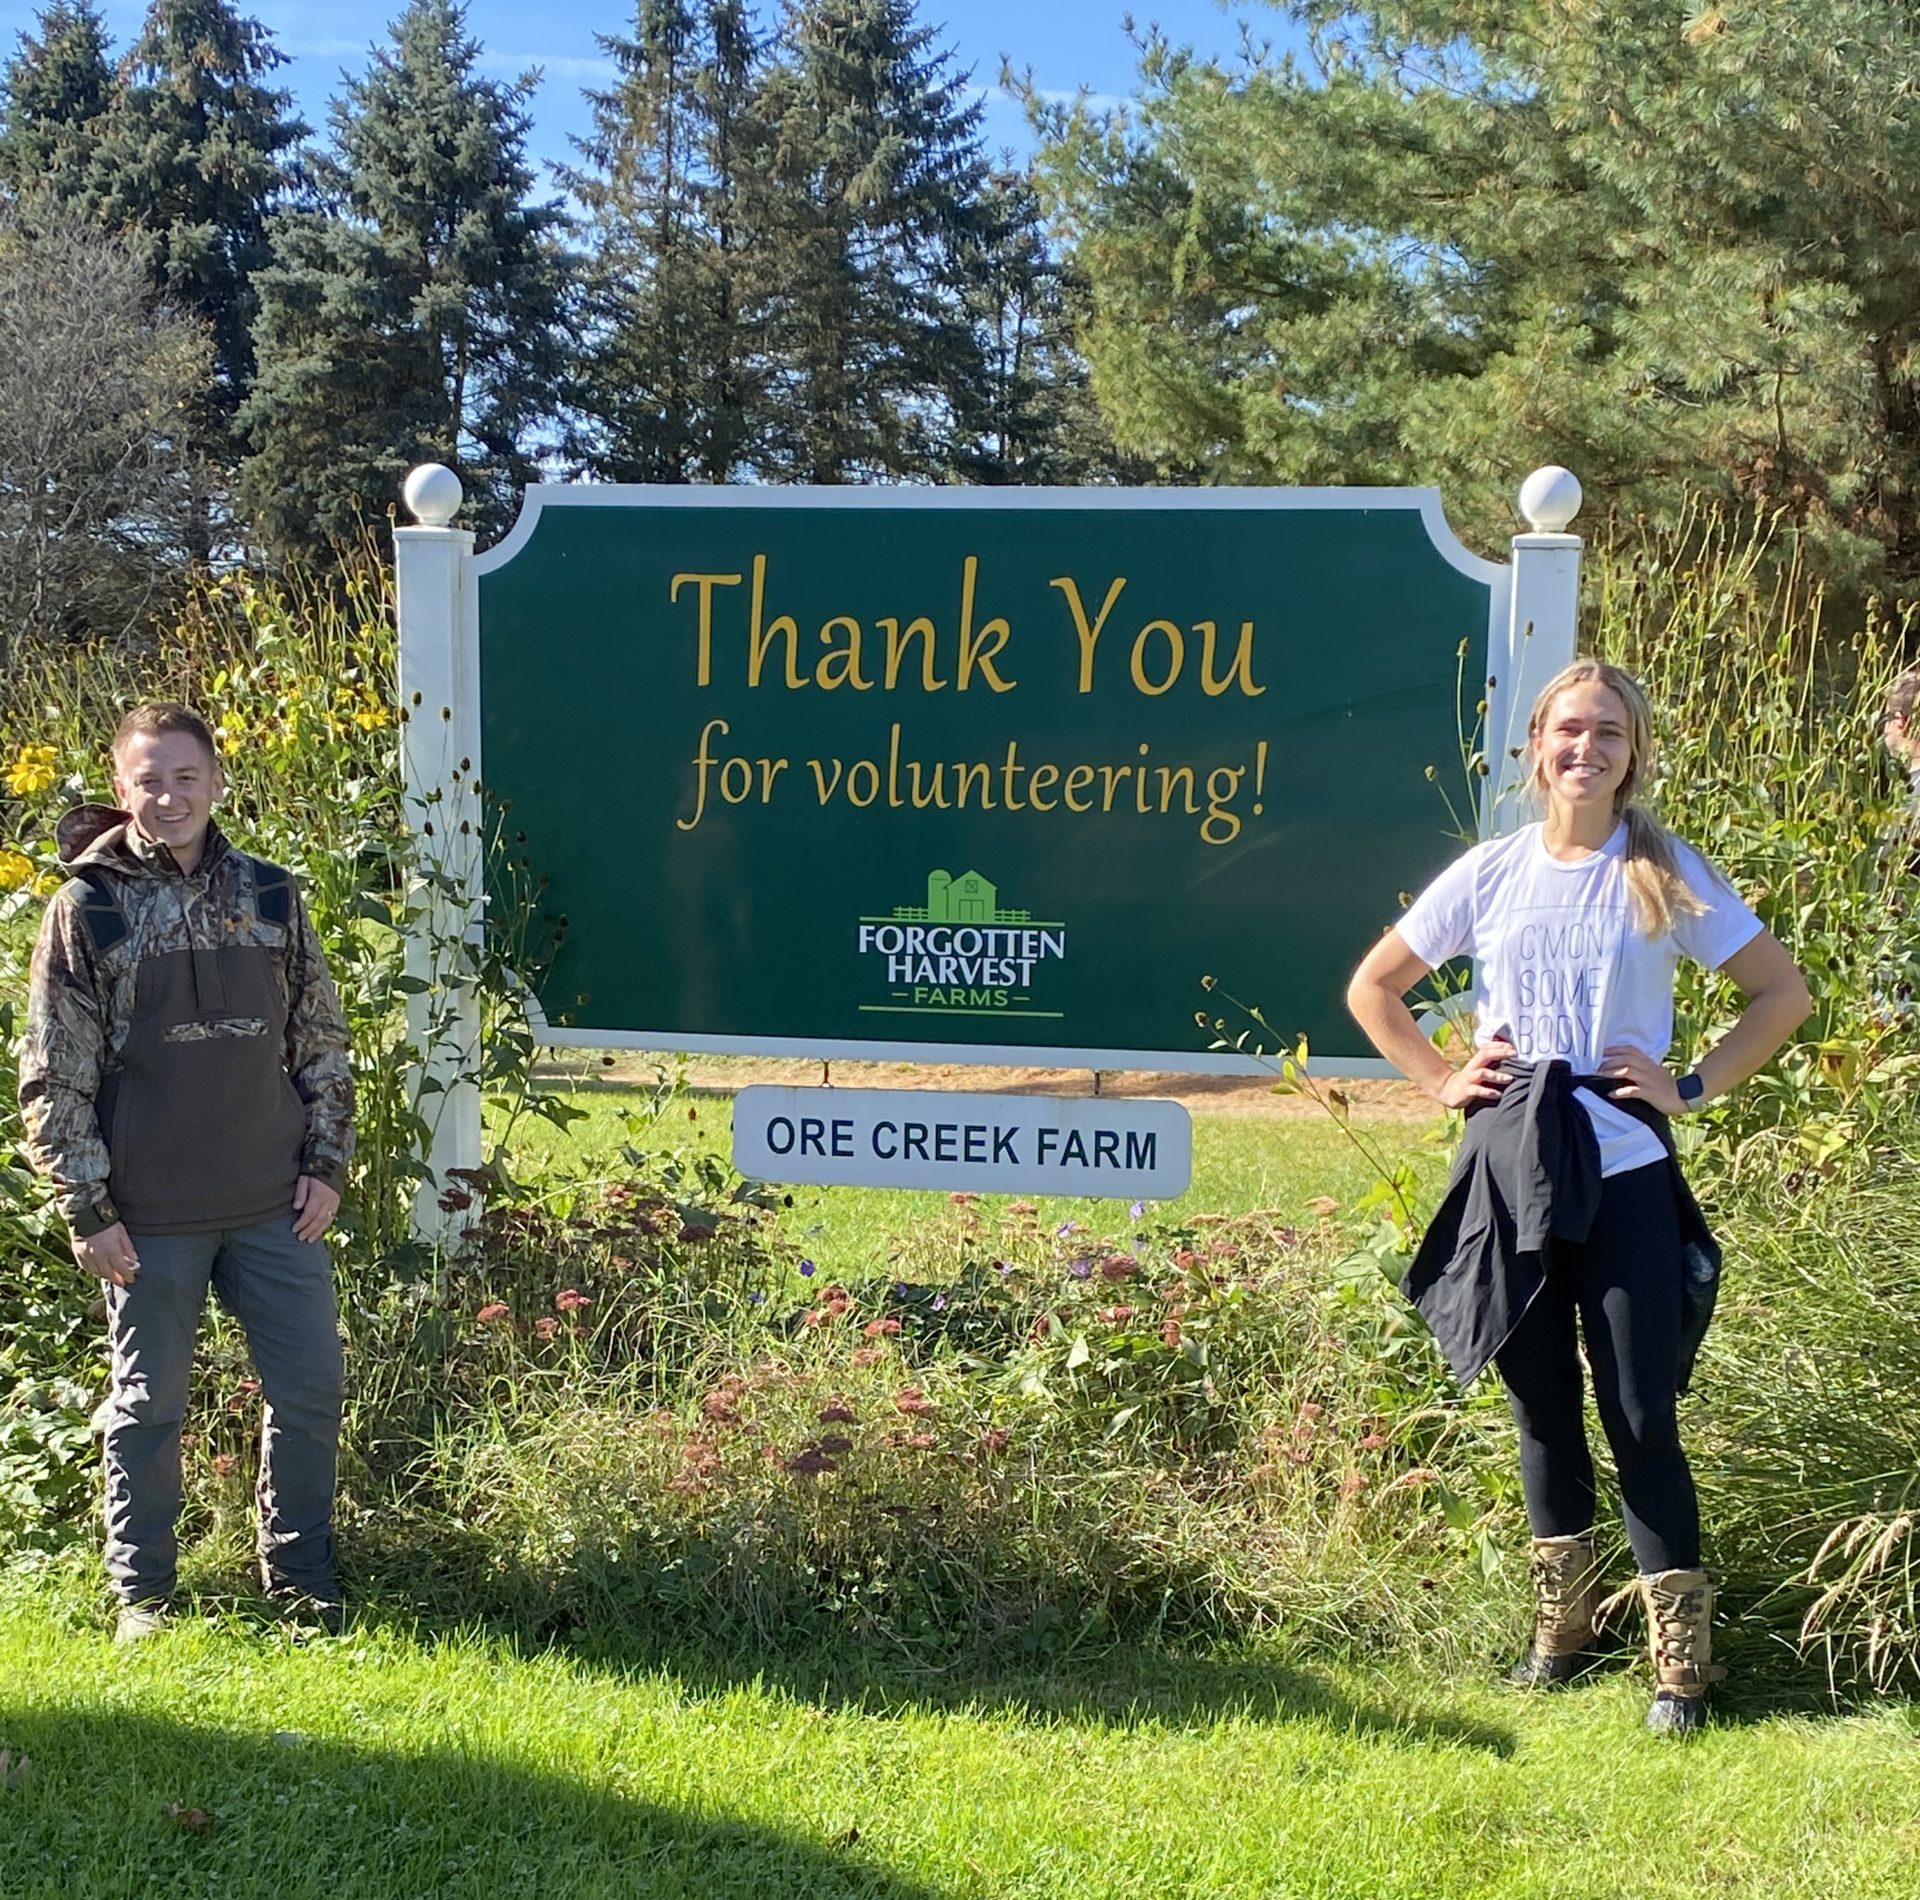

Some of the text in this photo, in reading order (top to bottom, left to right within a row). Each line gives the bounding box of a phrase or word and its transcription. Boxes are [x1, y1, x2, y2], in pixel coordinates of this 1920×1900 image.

[671, 553, 1267, 696] Thank You
[676, 719, 1268, 845] for volunteering!
[859, 925, 1065, 959] FORGOTTEN
[1519, 922, 1605, 961] C'MON
[888, 955, 1037, 987] HARVEST
[1519, 968, 1603, 1008] SOME
[1518, 1014, 1598, 1058] BODY
[766, 1116, 1156, 1171] ORE CREEK FARM
